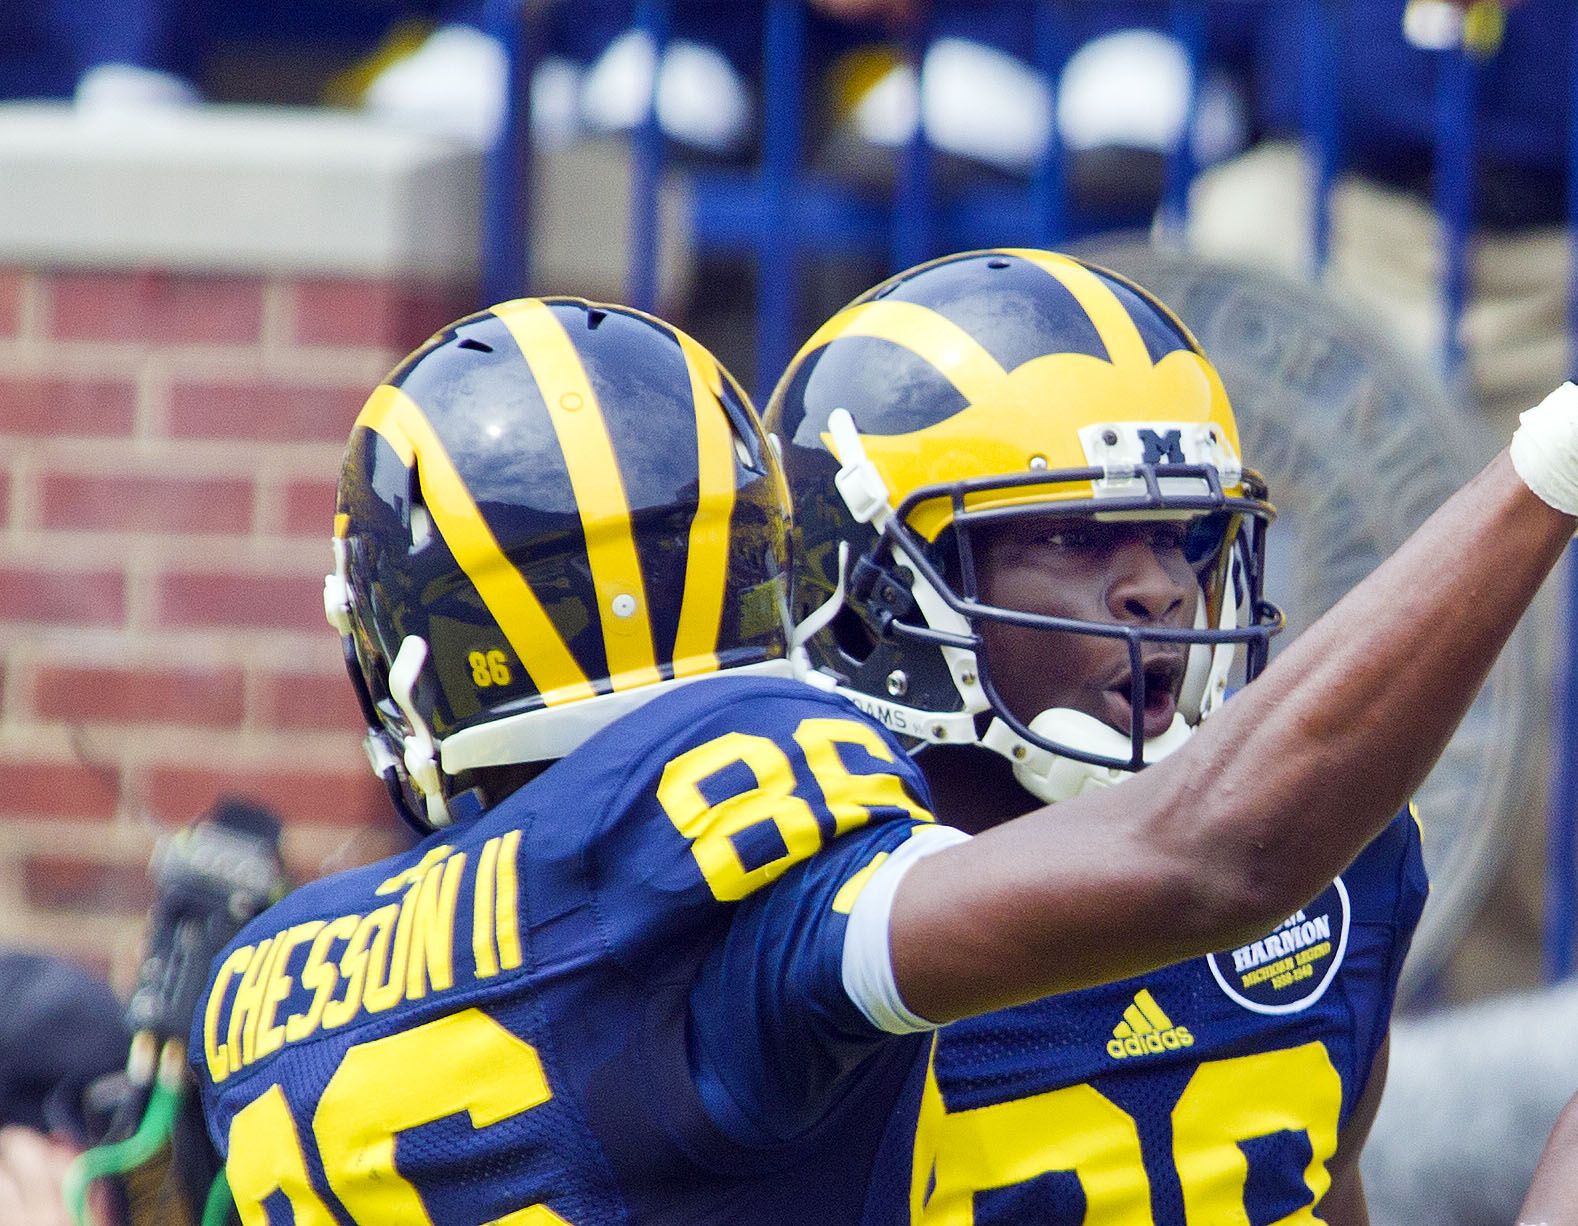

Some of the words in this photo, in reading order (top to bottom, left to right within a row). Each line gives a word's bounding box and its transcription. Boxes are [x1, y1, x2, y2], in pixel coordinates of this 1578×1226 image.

[1137, 429, 1185, 464] M
[468, 650, 511, 687] 86
[656, 718, 941, 904] 86
[204, 851, 467, 1083] CHESSON
[1231, 914, 1331, 973] HARMON
[1106, 1026, 1195, 1059] adidas
